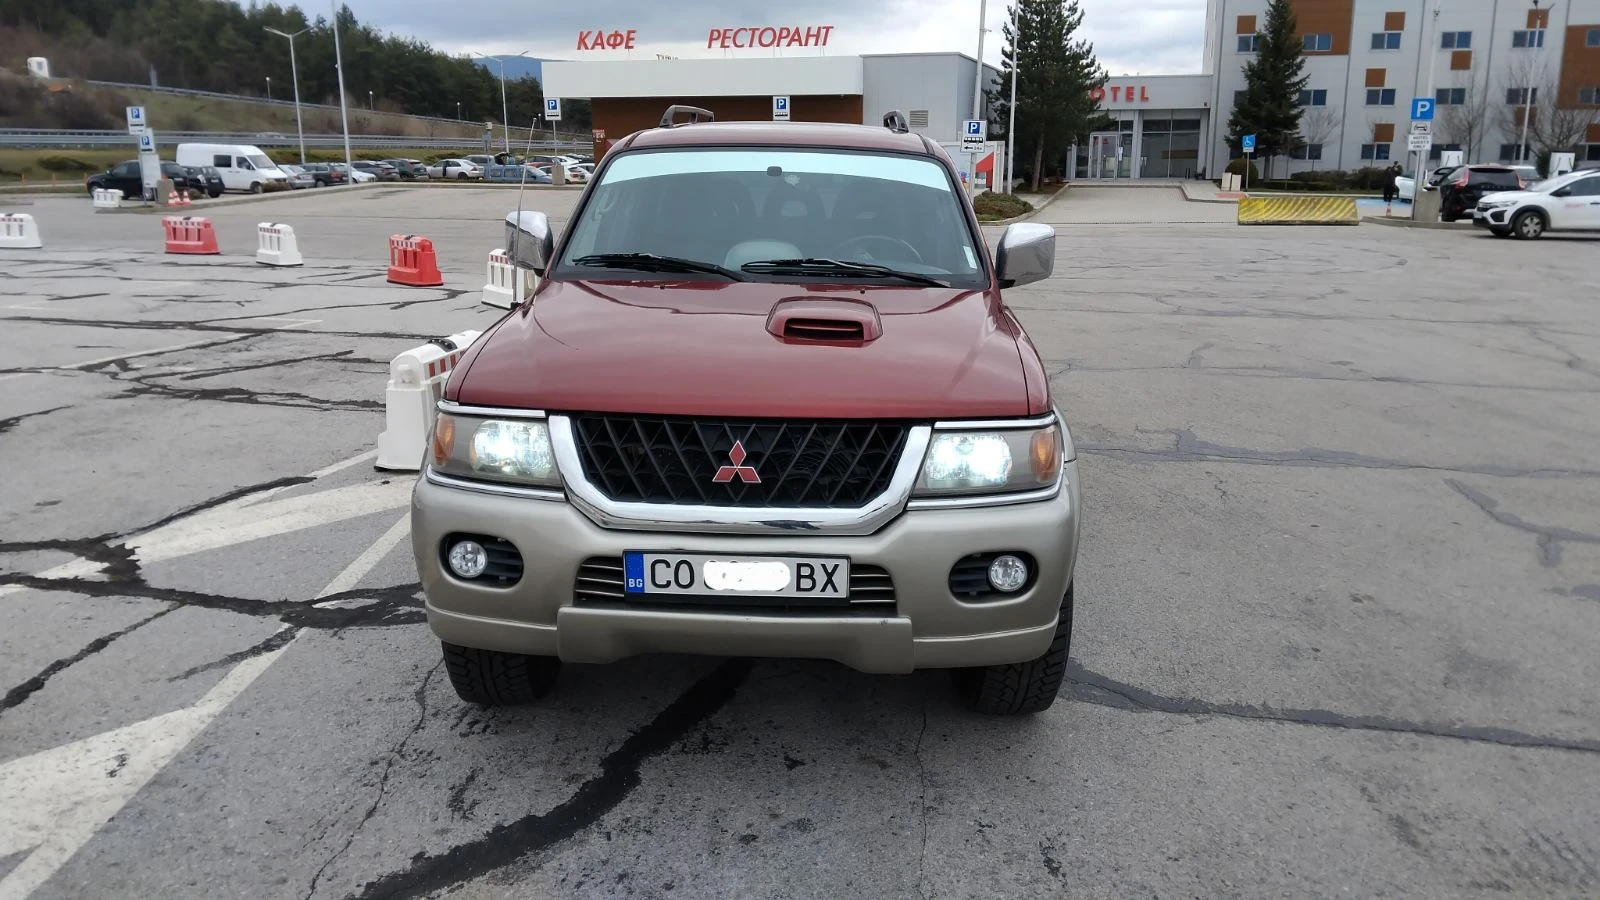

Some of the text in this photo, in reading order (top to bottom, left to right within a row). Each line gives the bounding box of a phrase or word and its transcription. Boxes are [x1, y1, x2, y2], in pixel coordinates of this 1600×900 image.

[577, 26, 834, 50] КАФЕ РЕСТОРАНТ
[1089, 85, 1149, 103] OTEL
[549, 100, 555, 110] P
[778, 99, 785, 109] P
[1416, 100, 1431, 118] P
[970, 122, 978, 133] P
[650, 558, 695, 589] CO
[795, 562, 840, 593] BX
[628, 578, 643, 588] BG
